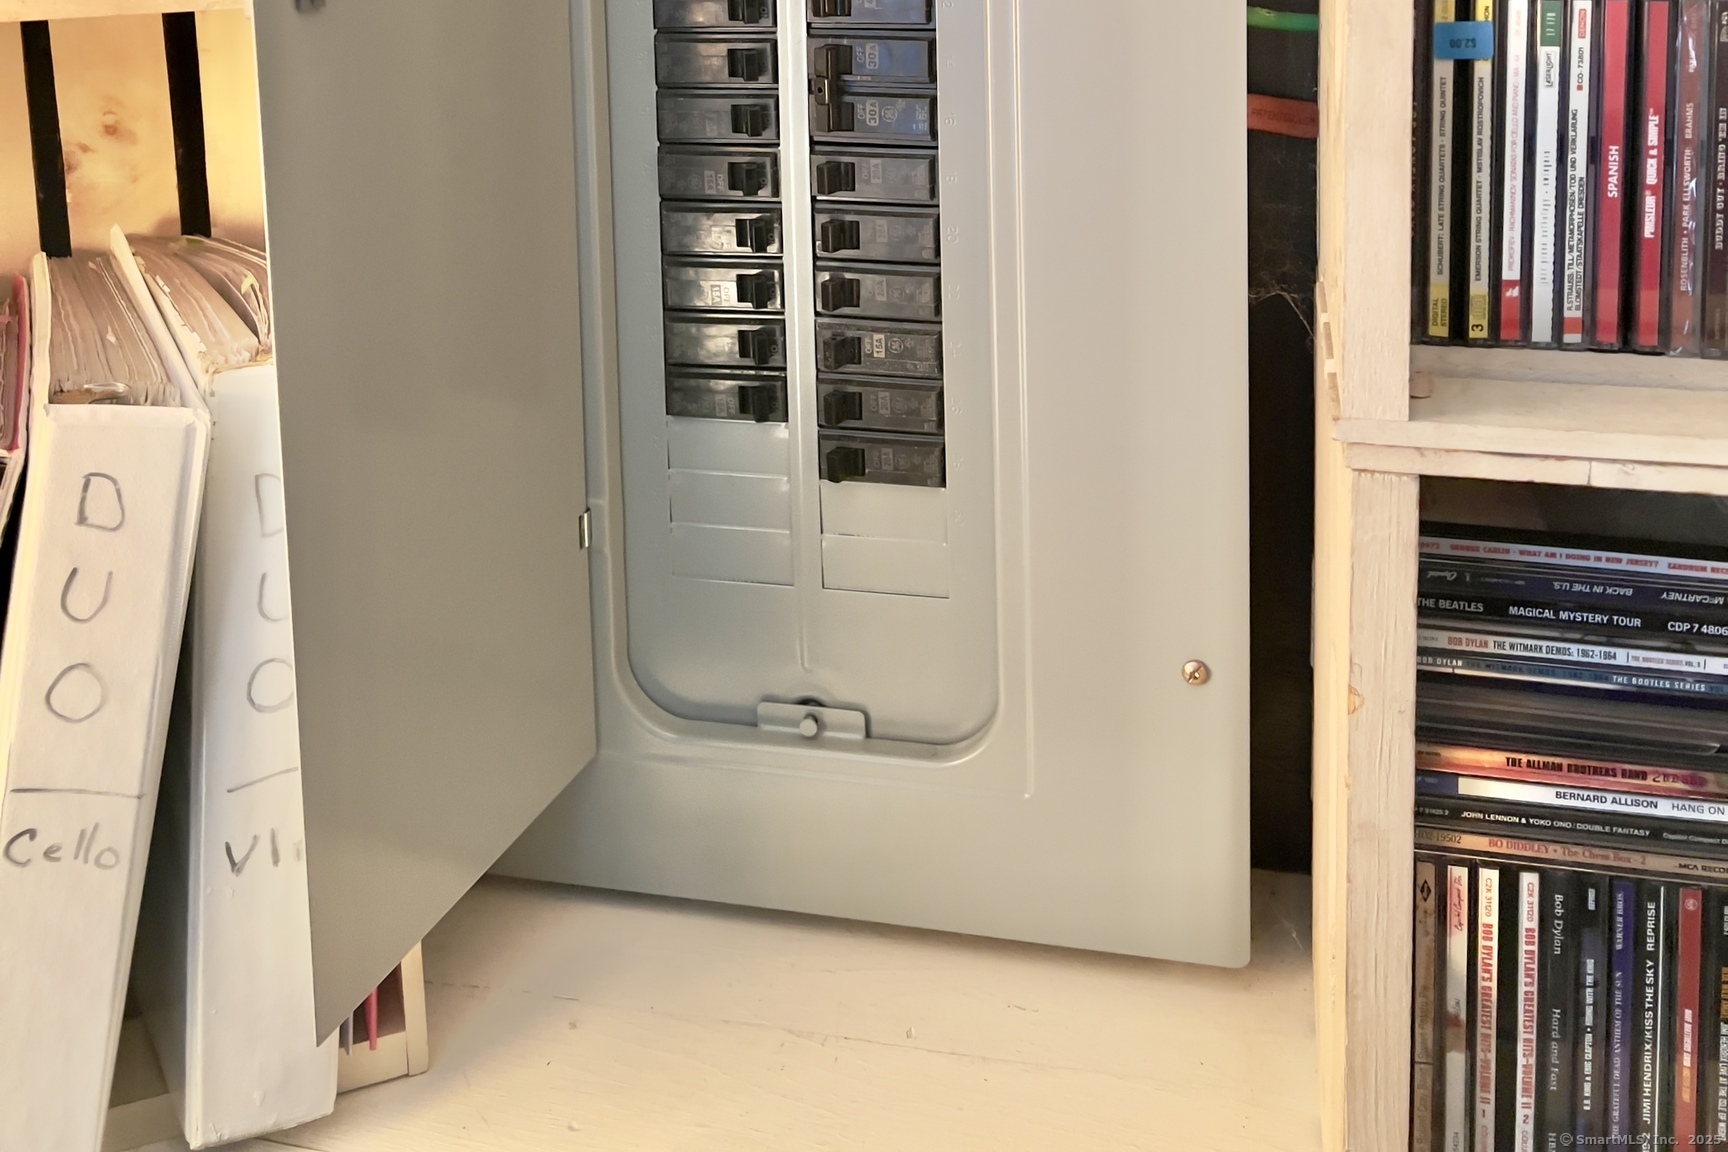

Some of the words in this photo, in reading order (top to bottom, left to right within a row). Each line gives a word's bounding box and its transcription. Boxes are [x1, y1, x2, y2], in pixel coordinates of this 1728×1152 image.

[867, 45, 877, 67] 30A
[1439, 76, 1447, 109] QUINTET
[857, 102, 865, 120] OFF
[867, 102, 877, 124] 30A
[1438, 110, 1447, 137] STRING
[1685, 102, 1695, 139] BRAHMS
[1438, 144, 1446, 183] QUARTETS
[1570, 157, 1578, 172] UND
[1606, 145, 1620, 198] SPANISH
[1646, 157, 1657, 185] QUICK
[1438, 184, 1446, 212] STRING
[1475, 179, 1484, 215] QUARTET
[1577, 176, 1585, 209] DRESDEN
[1437, 213, 1445, 231] LATE
[1682, 204, 1691, 228] PARK
[1475, 216, 1483, 243] STRING
[1474, 244, 1482, 281] EMERSON
[1680, 236, 1690, 291] ROSENBLITH
[711, 285, 721, 305] 15A
[1471, 323, 1484, 333] 3
[864, 337, 872, 354] OFF
[874, 337, 883, 356] 15A
[727, 397, 735, 414] OFF
[1571, 584, 1591, 593] THE
[1592, 586, 1603, 594] IN
[1605, 587, 1633, 597] BACK
[1439, 599, 1484, 612] BEATLES
[1509, 606, 1556, 619] MAGICAL
[1559, 611, 1609, 625] MYSTERY
[1612, 616, 1642, 628] TOUR
[1667, 621, 1691, 633] CDP
[1692, 624, 1698, 632] 7
[1448, 636, 1463, 647] BOB
[1465, 638, 1489, 649] DYLAN
[1492, 640, 1508, 651] THE
[1509, 642, 1543, 654] WITMARK
[1545, 644, 1575, 657] DEMOS:
[1436, 657, 1463, 668] DYLAN
[1613, 675, 1629, 685] THE
[1631, 677, 1671, 689] BOOTLEG
[1674, 681, 1706, 692] SERIES
[1505, 756, 1524, 769] THE
[1526, 758, 1564, 772] ALLMAN
[1555, 790, 1608, 804] BERNARD
[1610, 795, 1659, 809] ALLISON
[1671, 802, 1705, 814] HANG
[1708, 805, 1726, 816] ON
[1461, 810, 1484, 820] JOHN
[1485, 813, 1519, 824] LENNON
[1520, 816, 1527, 825] &
[1529, 818, 1552, 827] YOKO
[1613, 826, 1651, 837] FANTASY
[3, 821, 121, 872] Cello
[1488, 838, 1503, 849] BO
[1505, 841, 1549, 856] DIDDLEY
[1678, 863, 1699, 871] MCA
[1484, 877, 1493, 894] C2K
[1526, 882, 1536, 899] C2K
[1554, 894, 1564, 917] Bob
[1482, 922, 1494, 941] BOB
[1524, 927, 1536, 947] BOB
[1552, 918, 1564, 955] Dylan
[1646, 901, 1656, 951] REPRISE
[1482, 945, 1494, 982] DYLAN'S
[1523, 949, 1536, 987] DYLAN'S
[1646, 959, 1655, 984] SKY
[1481, 985, 1493, 1030] GREATEST
[1645, 985, 1655, 1008] THE
[1522, 990, 1535, 1035] GREATEST
[1551, 1008, 1562, 1039] Hard
[1550, 1041, 1560, 1064] and
[1643, 1010, 1655, 1097] HENDRIX/KISS
[1550, 1067, 1559, 1091] Fast
[1643, 1099, 1653, 1124] JIMI
